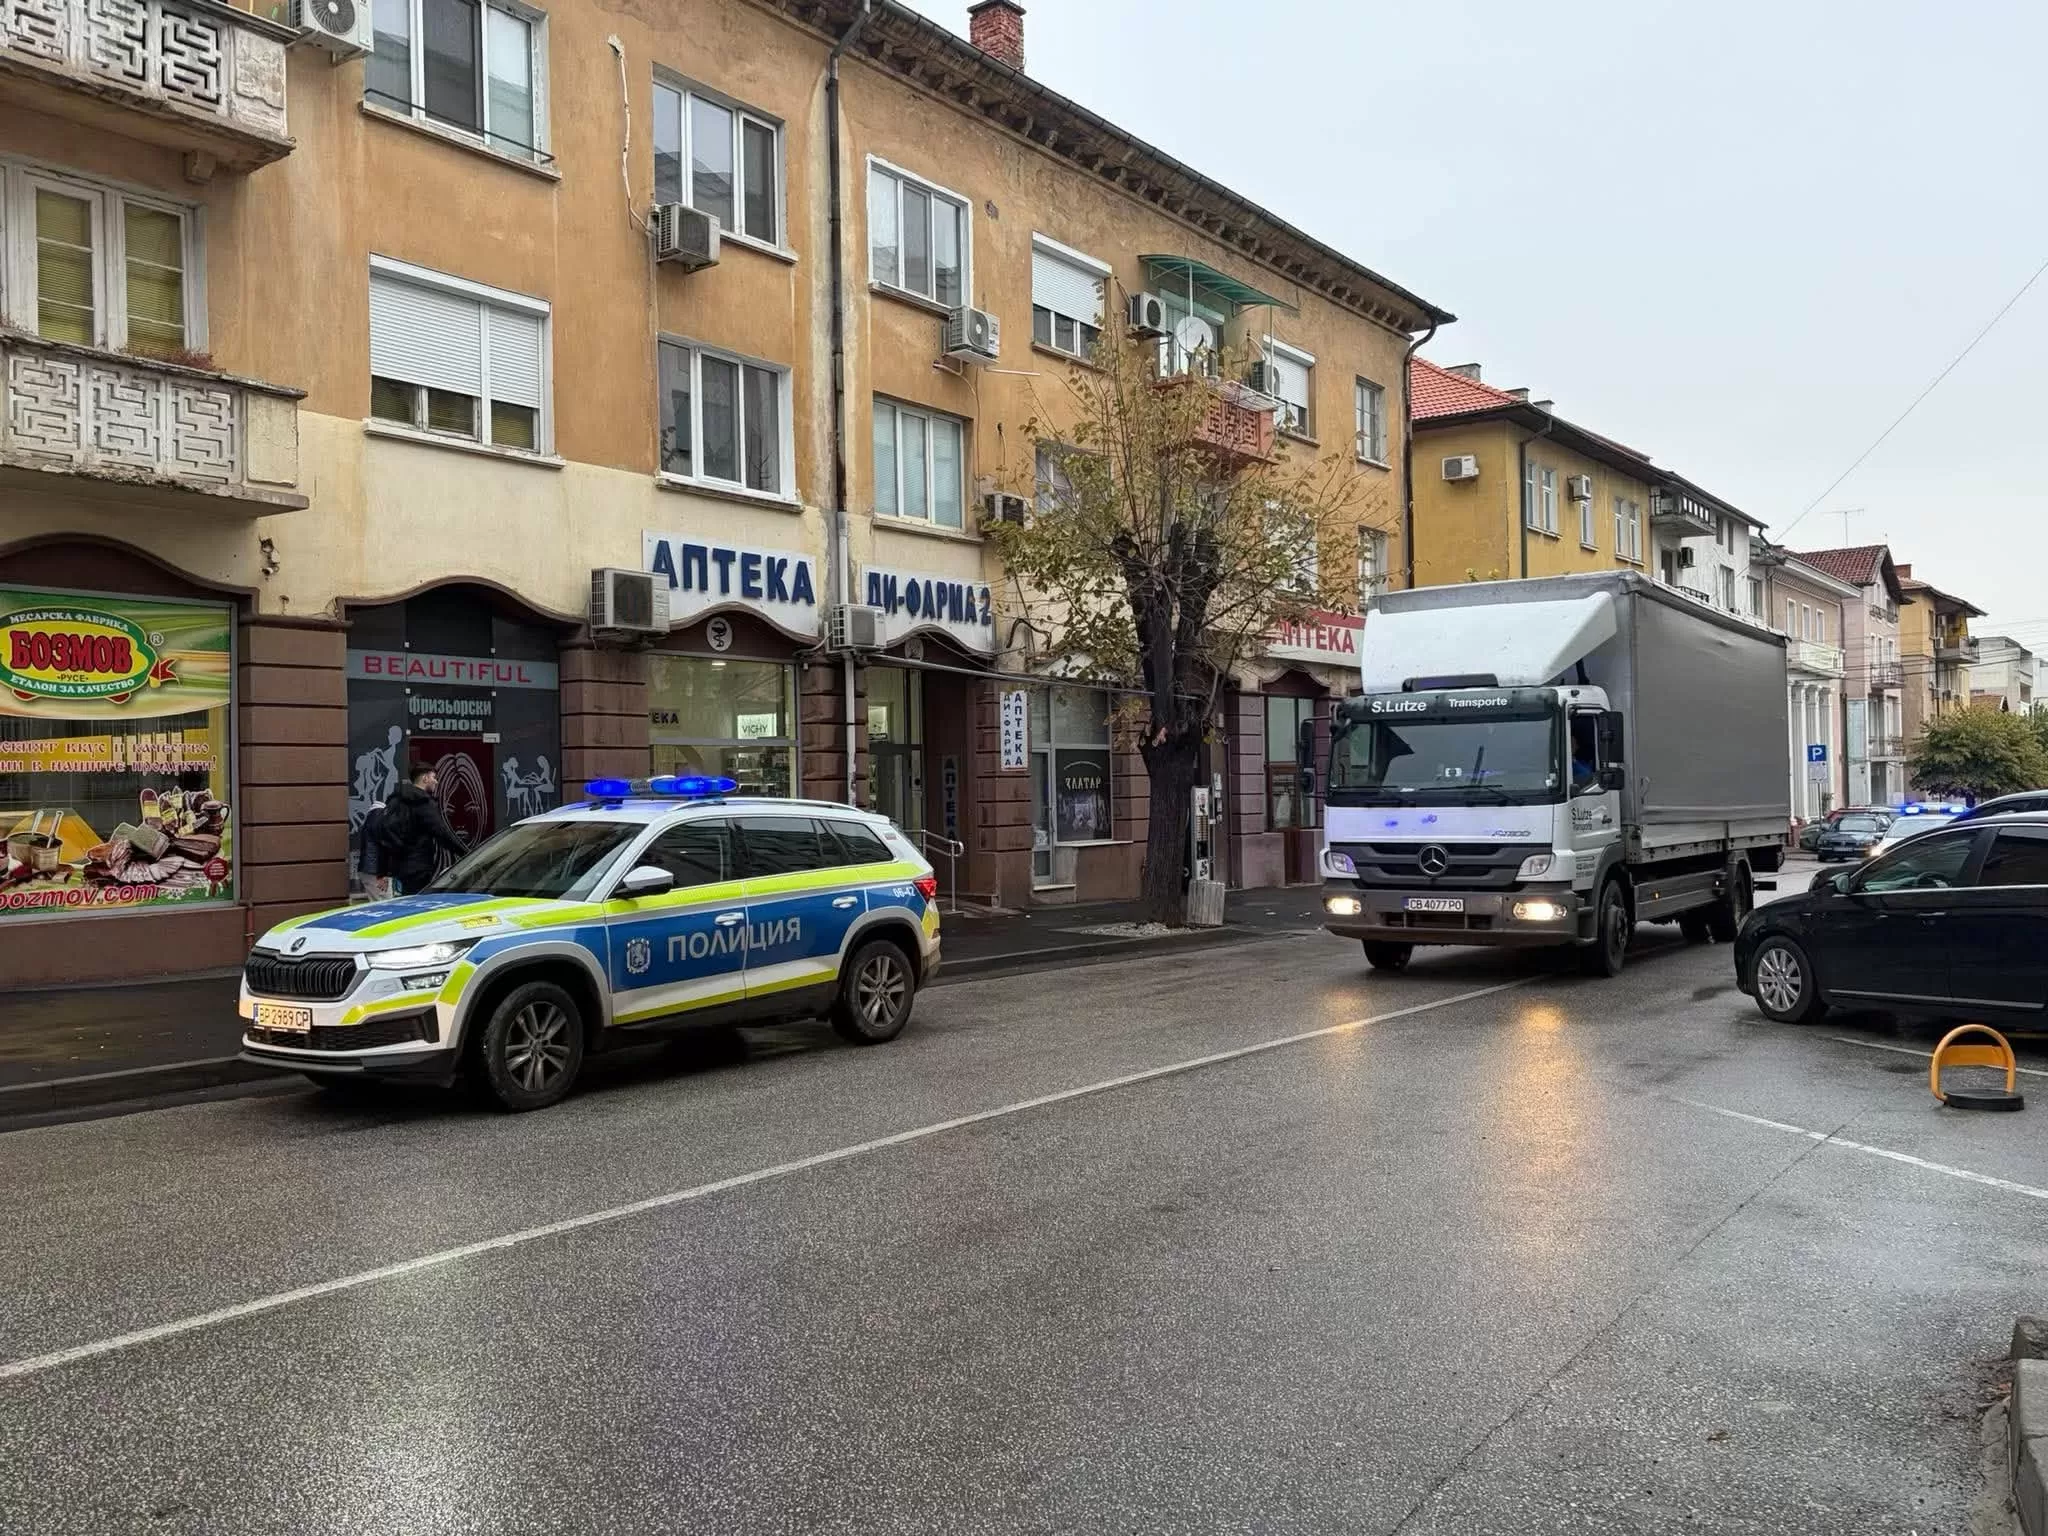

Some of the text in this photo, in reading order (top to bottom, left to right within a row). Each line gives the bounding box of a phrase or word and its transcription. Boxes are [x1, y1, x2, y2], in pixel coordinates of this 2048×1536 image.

[653, 539, 815, 606] АПТЕКА
[867, 571, 992, 625] ДИ-ФАРМА 2
[9, 612, 129, 632] МЕСАРСКА ФАБРИКА
[10, 630, 133, 674] БОЗМОВ
[364, 656, 532, 683] BEAUTIFUL
[10, 675, 136, 693] ЕТАЛОН ЗА КАЧЕСТВО
[1371, 698, 1508, 713] S.Lutze Transporte
[650, 711, 679, 725] ЕКА
[742, 725, 768, 734] VICHY
[1014, 693, 1023, 766] АПТЕКА
[1812, 747, 1823, 760] P
[667, 917, 801, 962] ПОЛИЦИЯ
